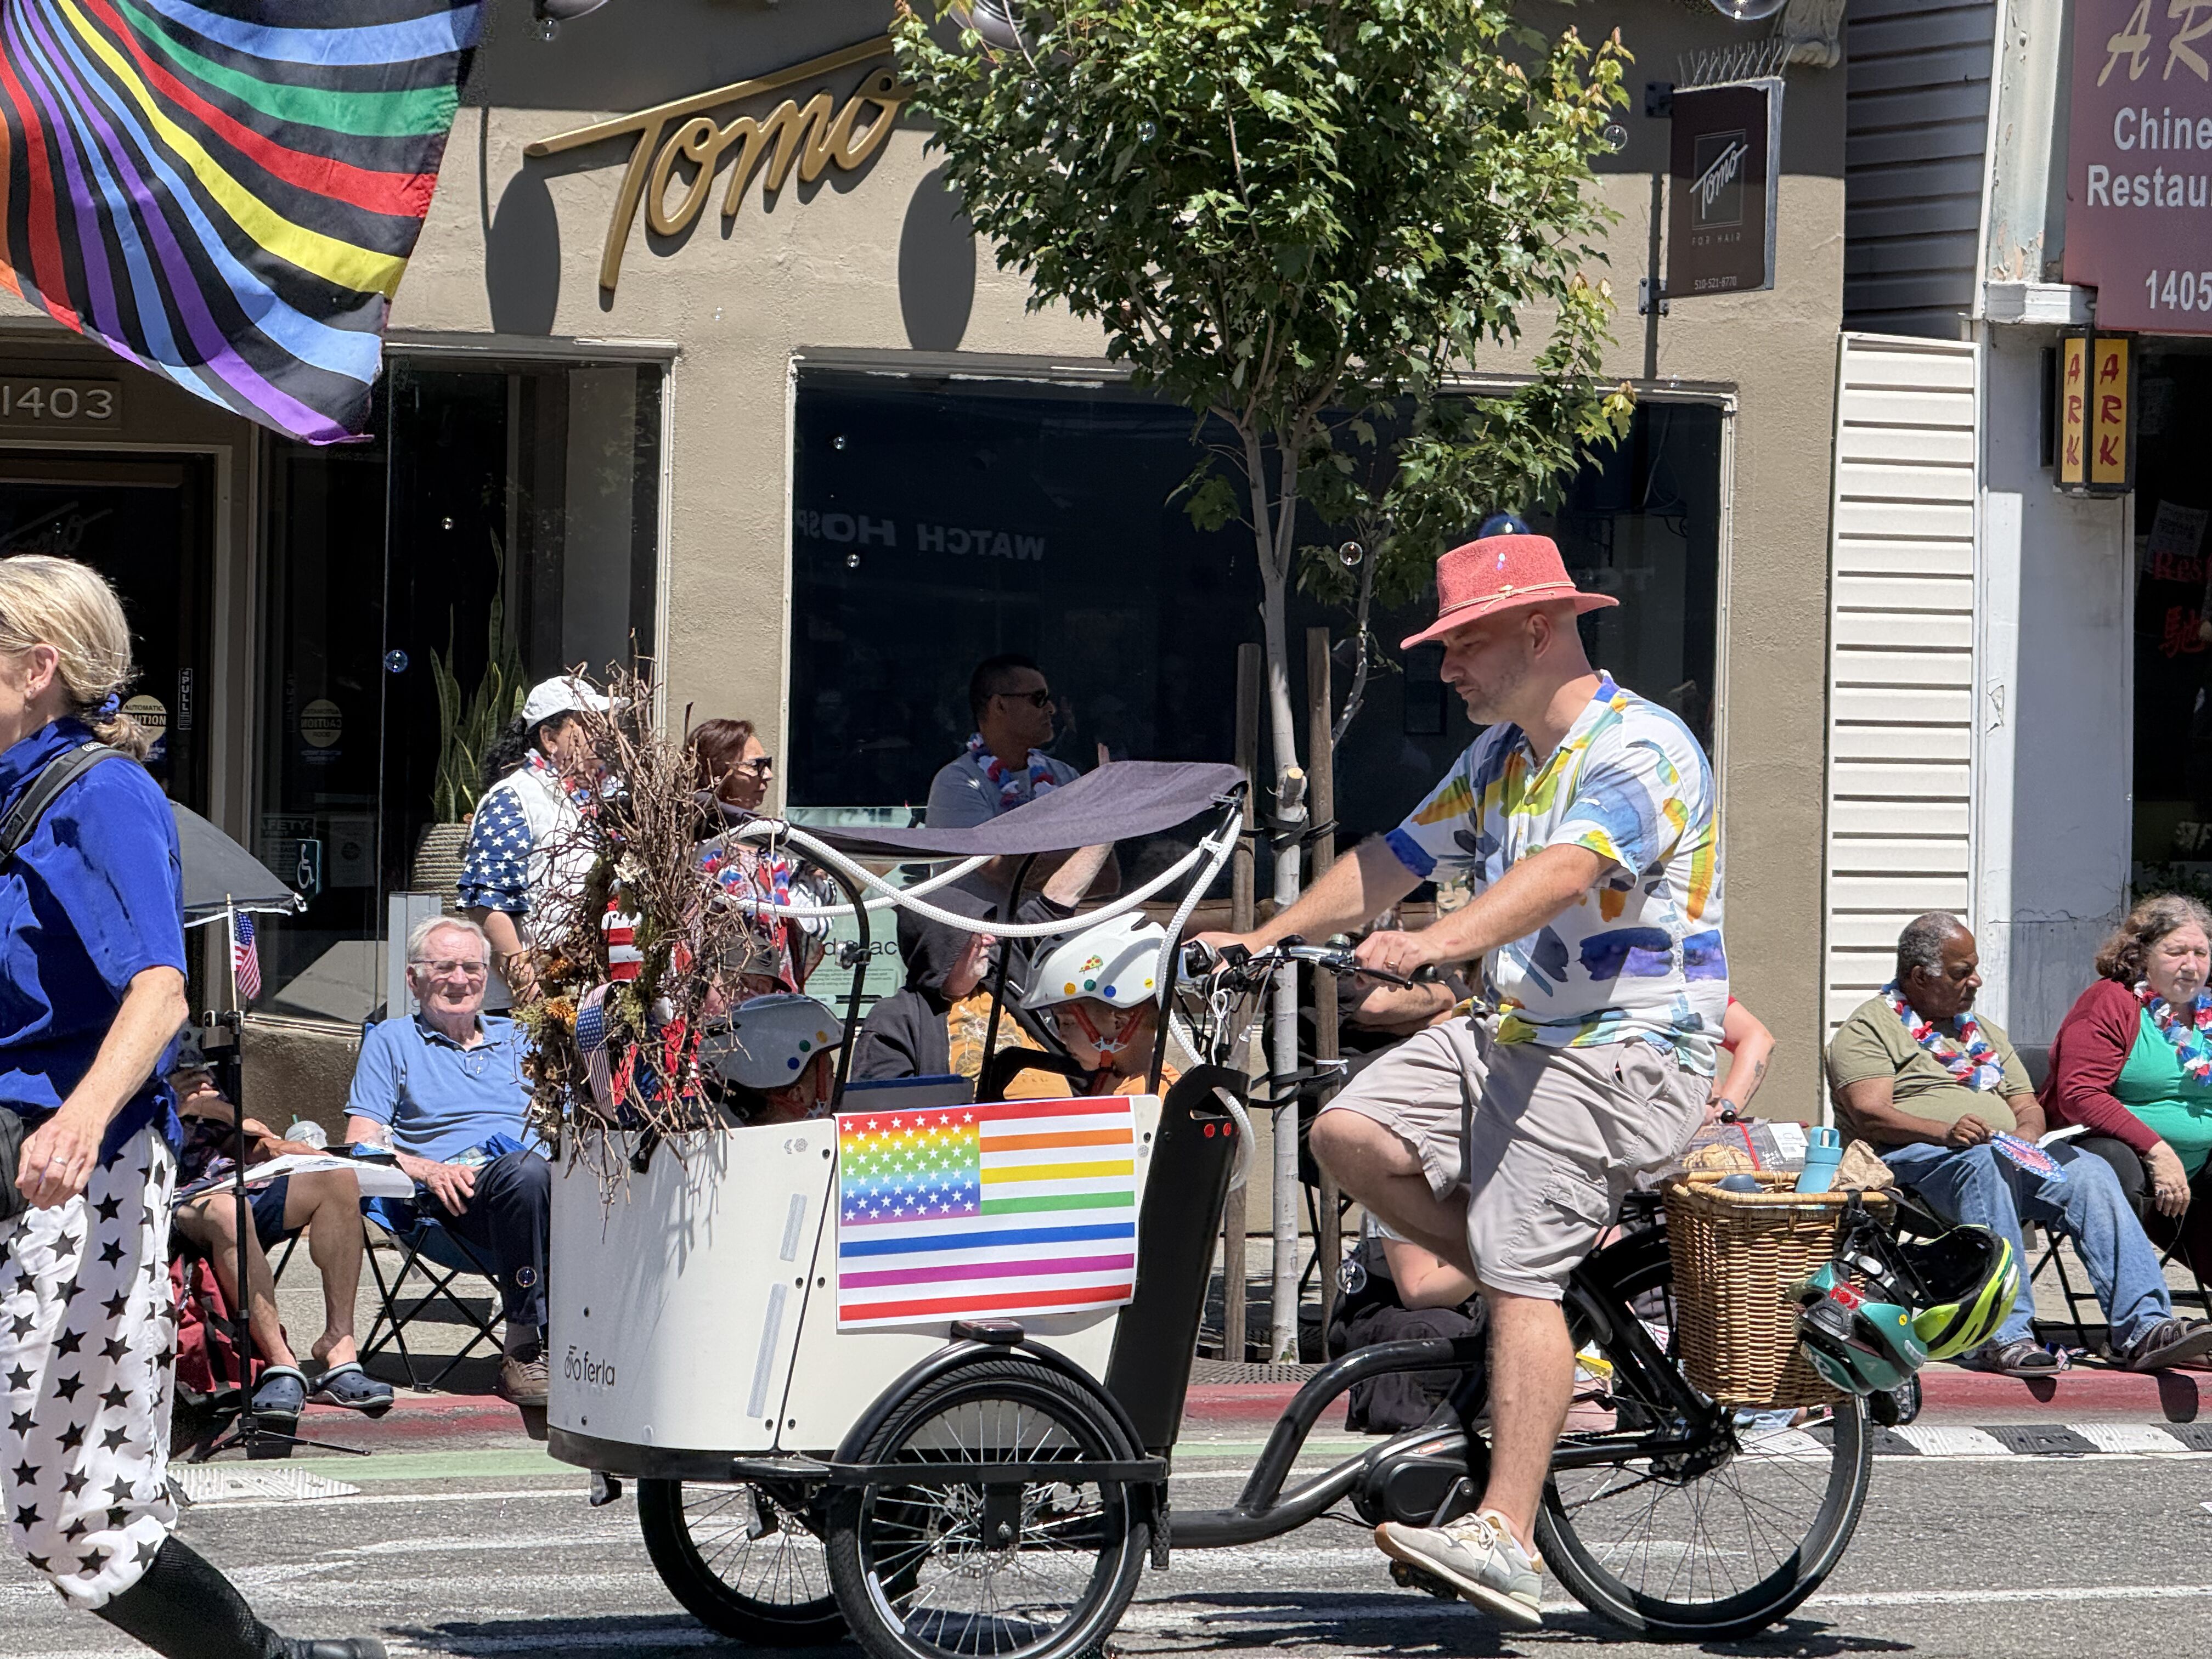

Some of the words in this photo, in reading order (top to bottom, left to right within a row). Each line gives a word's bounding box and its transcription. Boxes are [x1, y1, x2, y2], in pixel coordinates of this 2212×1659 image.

[2113, 106, 2212, 151] Chine
[524, 33, 917, 290] Tomo
[1689, 140, 1748, 220] Tomo
[2086, 164, 2212, 207] Restau
[1692, 236, 1710, 245] FOR
[1718, 233, 1741, 242] HAIR
[1694, 276, 1737, 290] 510-521-8770
[2145, 269, 2212, 312] 1405
[2, 386, 112, 420] 1403
[2066, 353, 2083, 466] ARK
[2099, 353, 2123, 466] ARK
[181, 676, 190, 711] PULL
[135, 714, 166, 725] UTION
[583, 1351, 615, 1387] ferla
